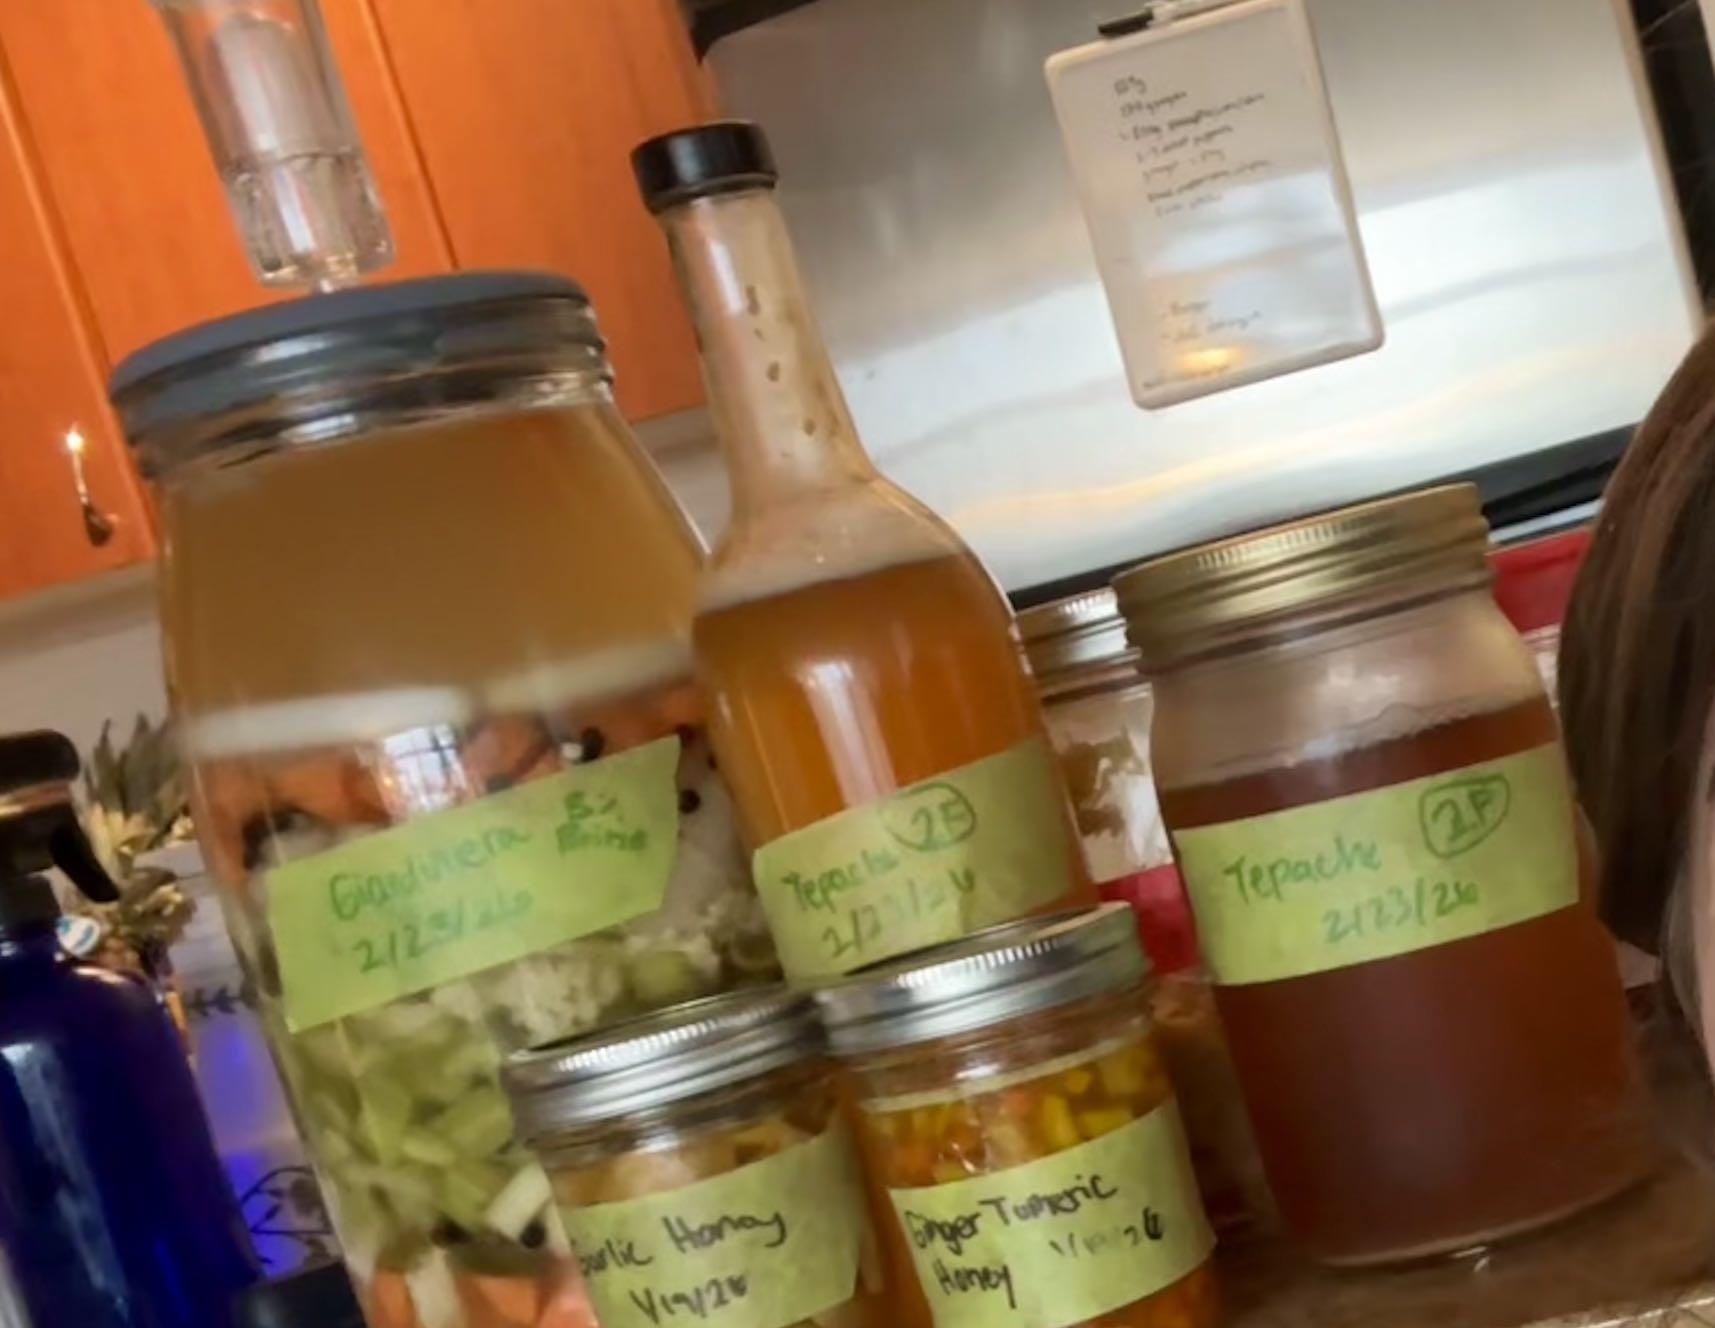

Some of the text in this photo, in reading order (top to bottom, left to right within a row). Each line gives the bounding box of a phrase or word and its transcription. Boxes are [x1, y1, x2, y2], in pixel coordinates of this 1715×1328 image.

[1223, 836, 1382, 905] Tepache
[661, 1211, 788, 1254] Honey
[933, 1258, 1017, 1310] Honey
